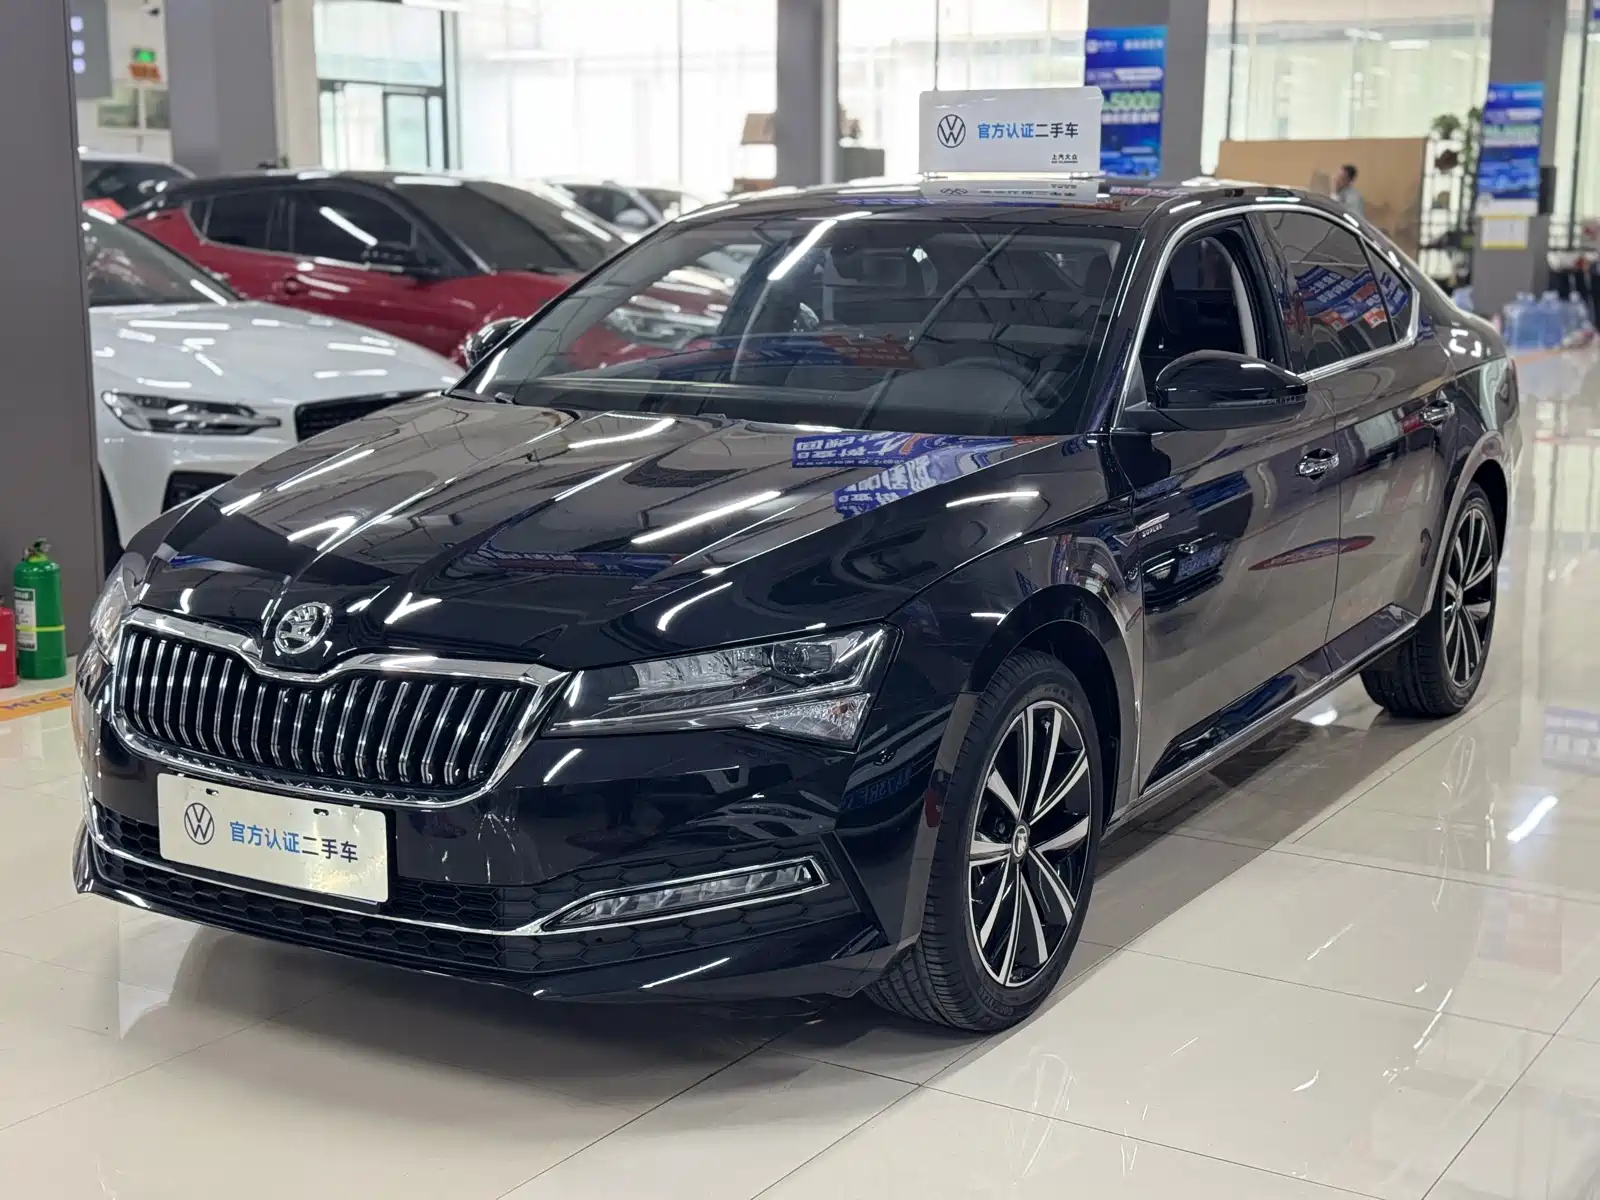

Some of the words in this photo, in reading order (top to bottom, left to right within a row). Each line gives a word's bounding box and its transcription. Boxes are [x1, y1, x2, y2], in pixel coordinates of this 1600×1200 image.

[977, 122, 1079, 139] 官方认证二手车
[229, 821, 359, 863] 官方认证二手车
